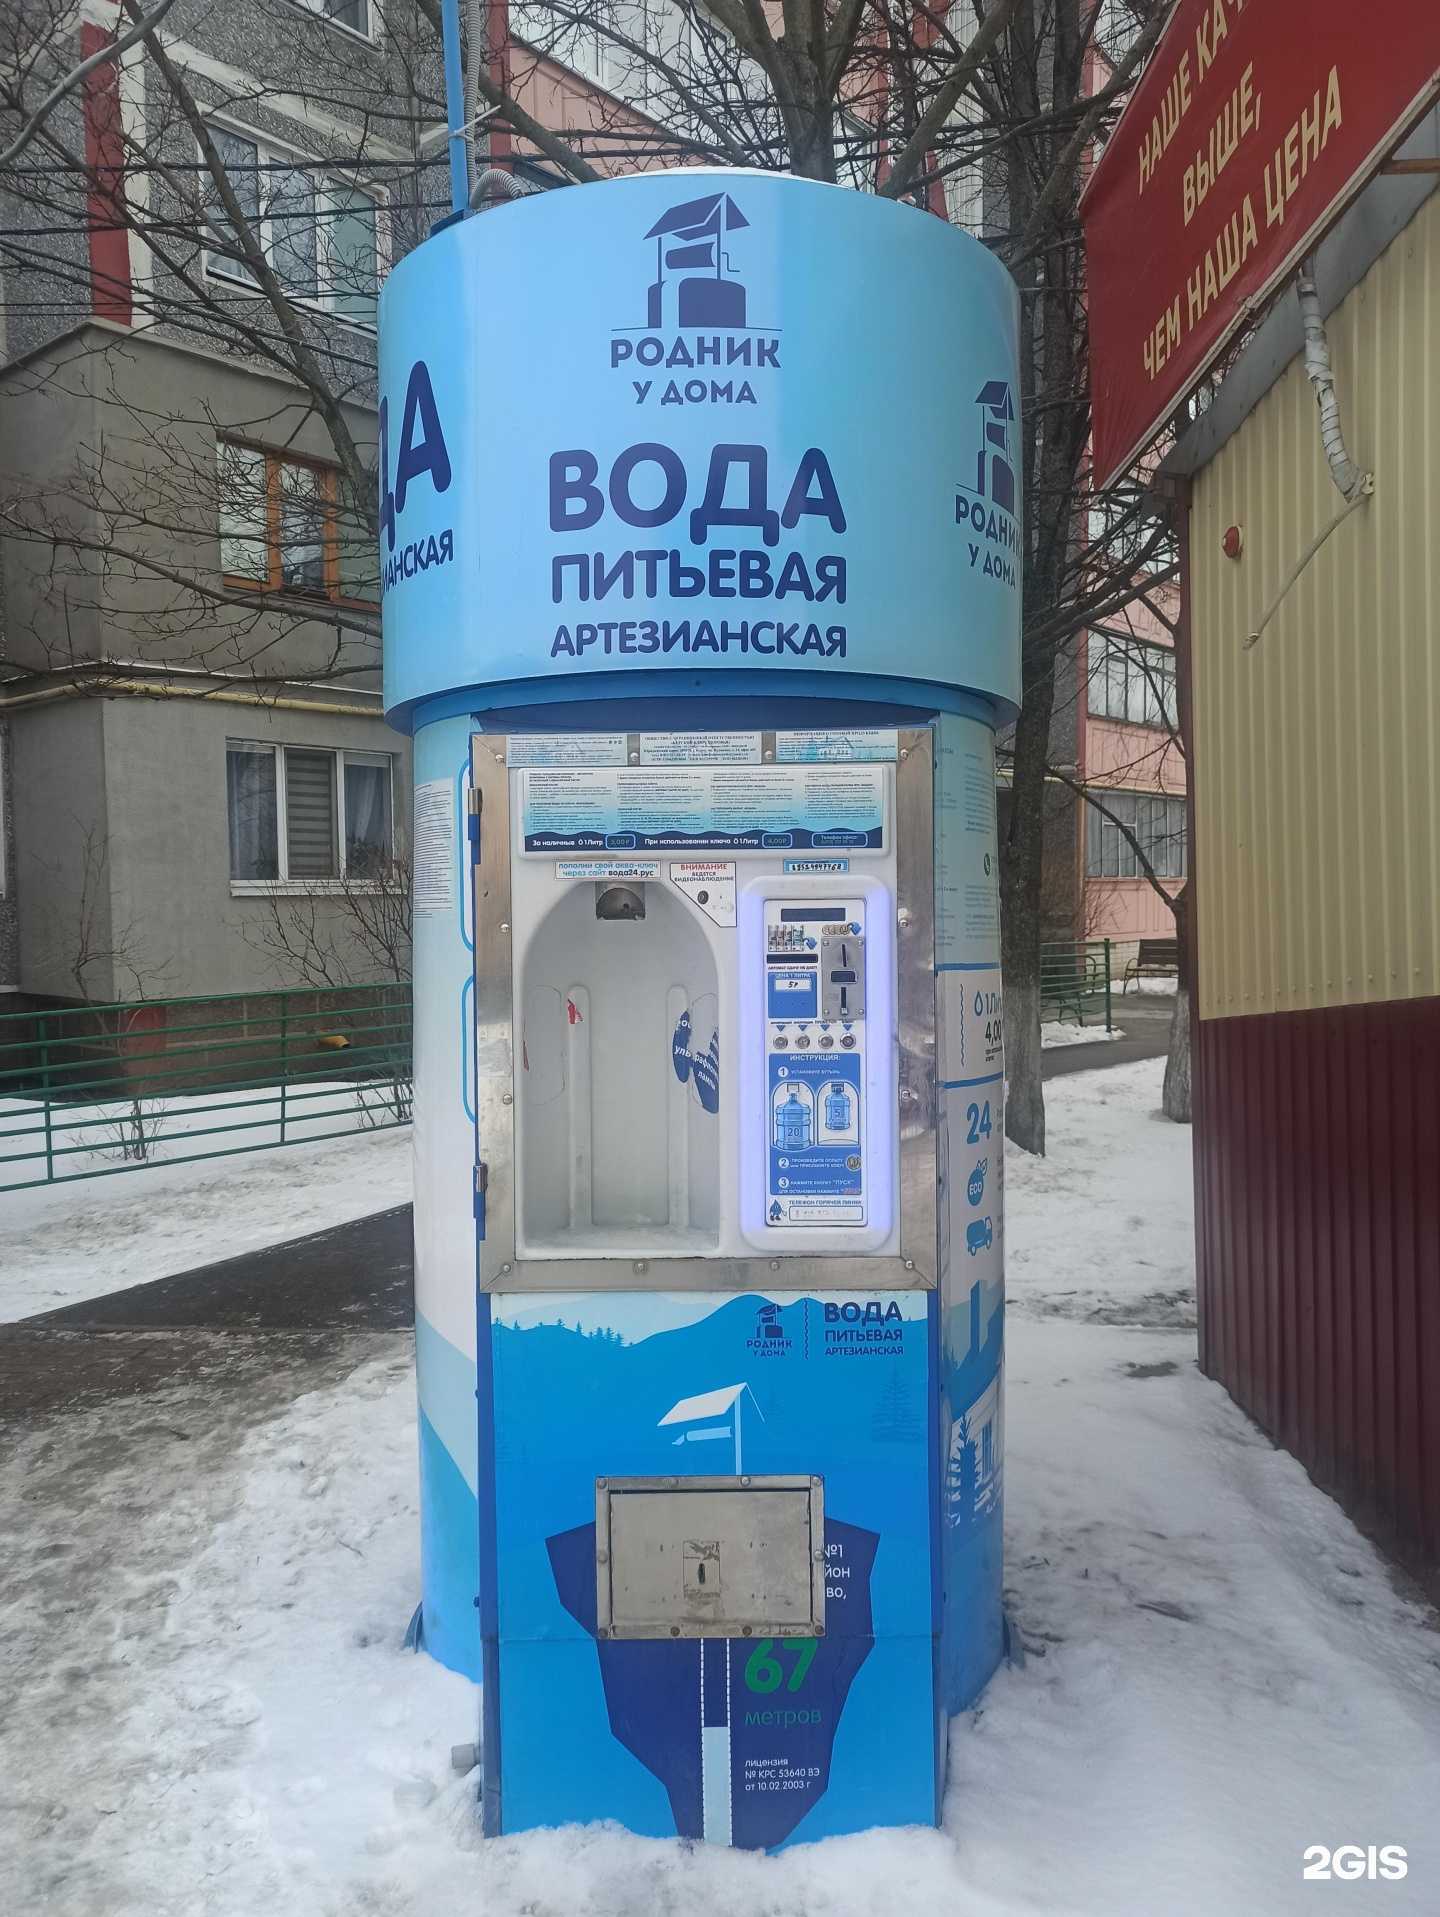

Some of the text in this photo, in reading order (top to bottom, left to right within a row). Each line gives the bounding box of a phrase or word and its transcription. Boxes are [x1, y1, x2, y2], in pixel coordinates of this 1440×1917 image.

[1138, 49, 1193, 195] НАШЕ
[1183, 61, 1262, 227] ВЫШЕ,
[1143, 64, 1343, 381] ЧЕМ НАША ЦЕНА
[610, 336, 782, 369] РОДНИК
[633, 380, 758, 405] У ДОМА
[549, 443, 847, 547] ВОДА
[551, 550, 847, 604] ПИТЬЕВАЯ
[968, 542, 1016, 590] У ДОМА
[550, 621, 847, 659] АРТЕЗИАНСКАЯ
[608, 868, 654, 878] вода24.рус
[680, 863, 728, 871] ВНИМАНИЕ
[789, 1054, 841, 1062] ИНСТРУКЦИЯ:
[966, 1099, 992, 1145] 24
[969, 1182, 983, 1196] ECO
[824, 1300, 903, 1327] ВОДА
[746, 1339, 793, 1349] РОДНИК
[824, 1328, 904, 1343] ПИТЬЕВАЯ
[824, 1345, 904, 1356] АРТЕЗИАНСКАЯ
[744, 1638, 818, 1694] 67
[744, 1706, 822, 1728] метров
[744, 1758, 789, 1768] лицензия
[758, 1769, 777, 1779] КРС
[778, 1768, 806, 1778] 53640
[757, 1780, 805, 1791] 10.02.2003
